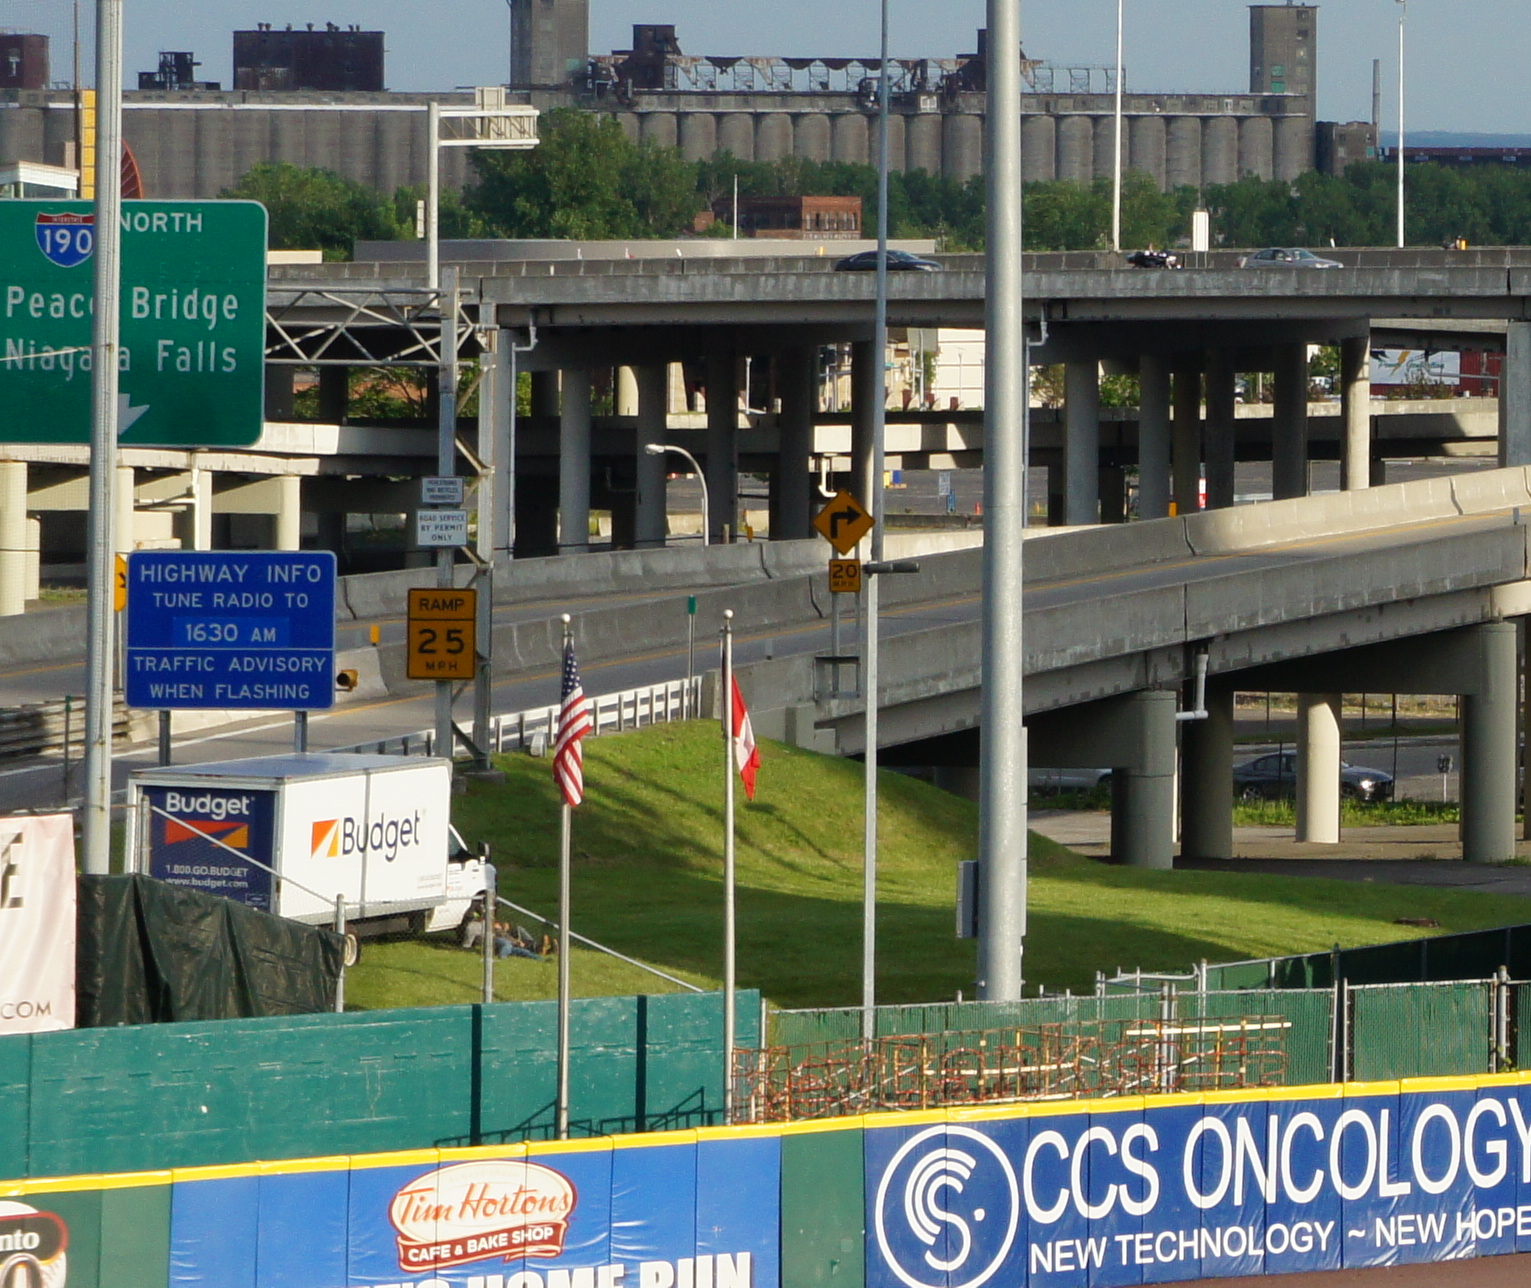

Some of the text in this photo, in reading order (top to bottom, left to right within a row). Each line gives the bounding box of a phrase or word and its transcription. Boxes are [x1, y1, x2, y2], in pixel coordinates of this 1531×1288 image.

[119, 212, 202, 233] NORTH
[43, 229, 93, 254] 190
[7, 286, 238, 330] Peac Bridge
[6, 338, 237, 381] Niagaa Falls
[435, 524, 463, 532] PERMIT
[440, 514, 465, 522] SERVICE
[141, 564, 321, 583] HIGHWAY INFO
[833, 564, 857, 579] 20
[153, 593, 309, 608] TUNE RADIO TO
[419, 598, 465, 611] RAMP
[186, 624, 276, 642] 1630 AM
[418, 628, 465, 654] 25
[134, 657, 326, 672] TRAFFIC ADVISORY
[425, 661, 458, 671] MPH
[150, 684, 310, 700] WHEN FLASHING
[166, 792, 250, 820] Budget
[342, 809, 420, 862] Budget
[165, 877, 248, 889] www.budget.com
[1024, 1123, 1160, 1223] CCS
[398, 1182, 571, 1226] Tim Hortons
[408, 1226, 554, 1263] CAFE & BAKE SHOP
[1031, 1237, 1108, 1275] NEW
[1114, 1221, 1333, 1271] TECHNOLOGY
[1375, 1213, 1446, 1247] NEW
